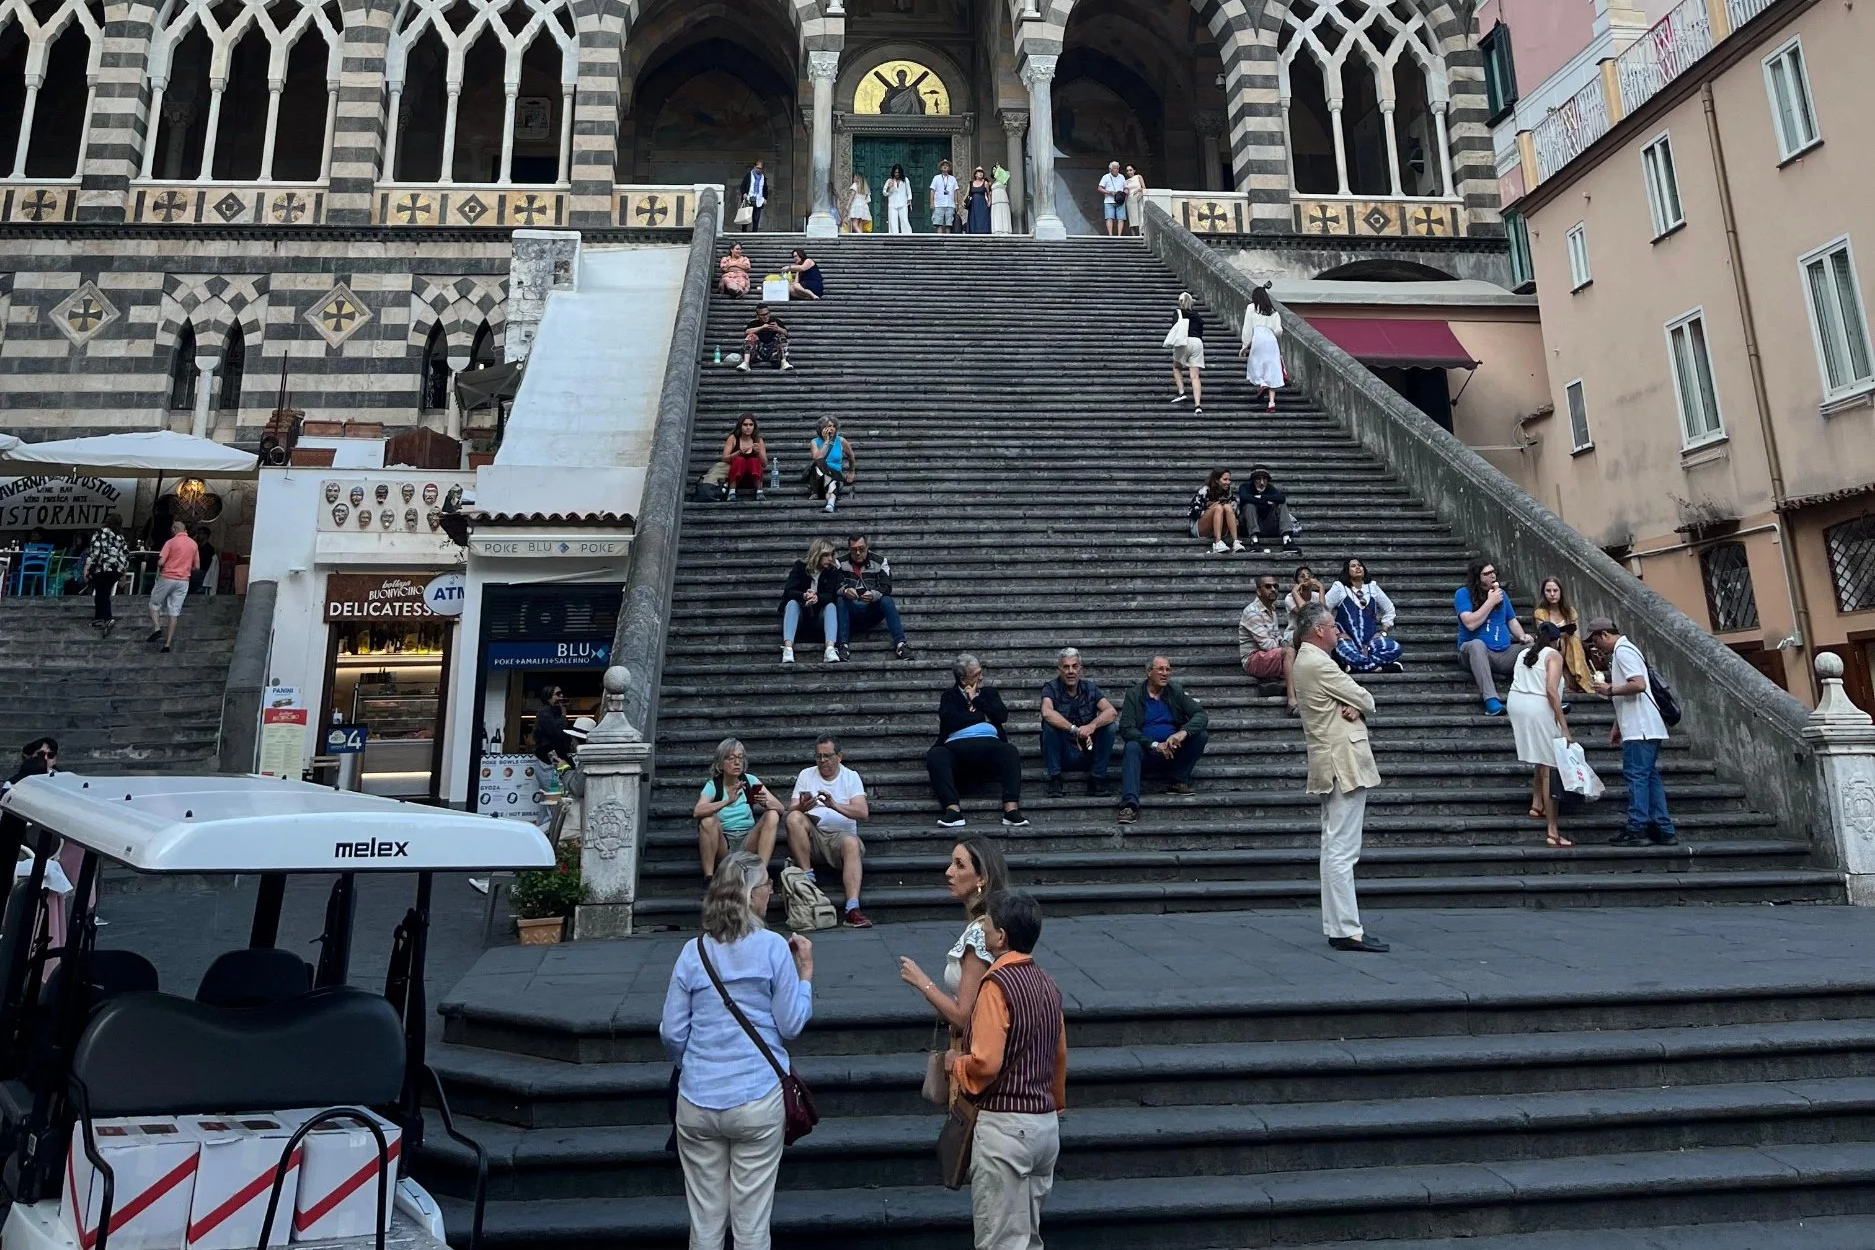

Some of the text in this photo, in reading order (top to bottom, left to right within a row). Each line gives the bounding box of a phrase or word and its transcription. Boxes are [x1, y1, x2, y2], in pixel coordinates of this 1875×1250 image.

[0, 476, 47, 500] AVERNA
[0, 505, 117, 526] ISTORANTE
[484, 542, 614, 553] POKE BLU POKE
[329, 601, 438, 617] DELICATESS
[557, 643, 590, 657] BLU
[347, 730, 362, 750] 4
[334, 837, 410, 858] melex
